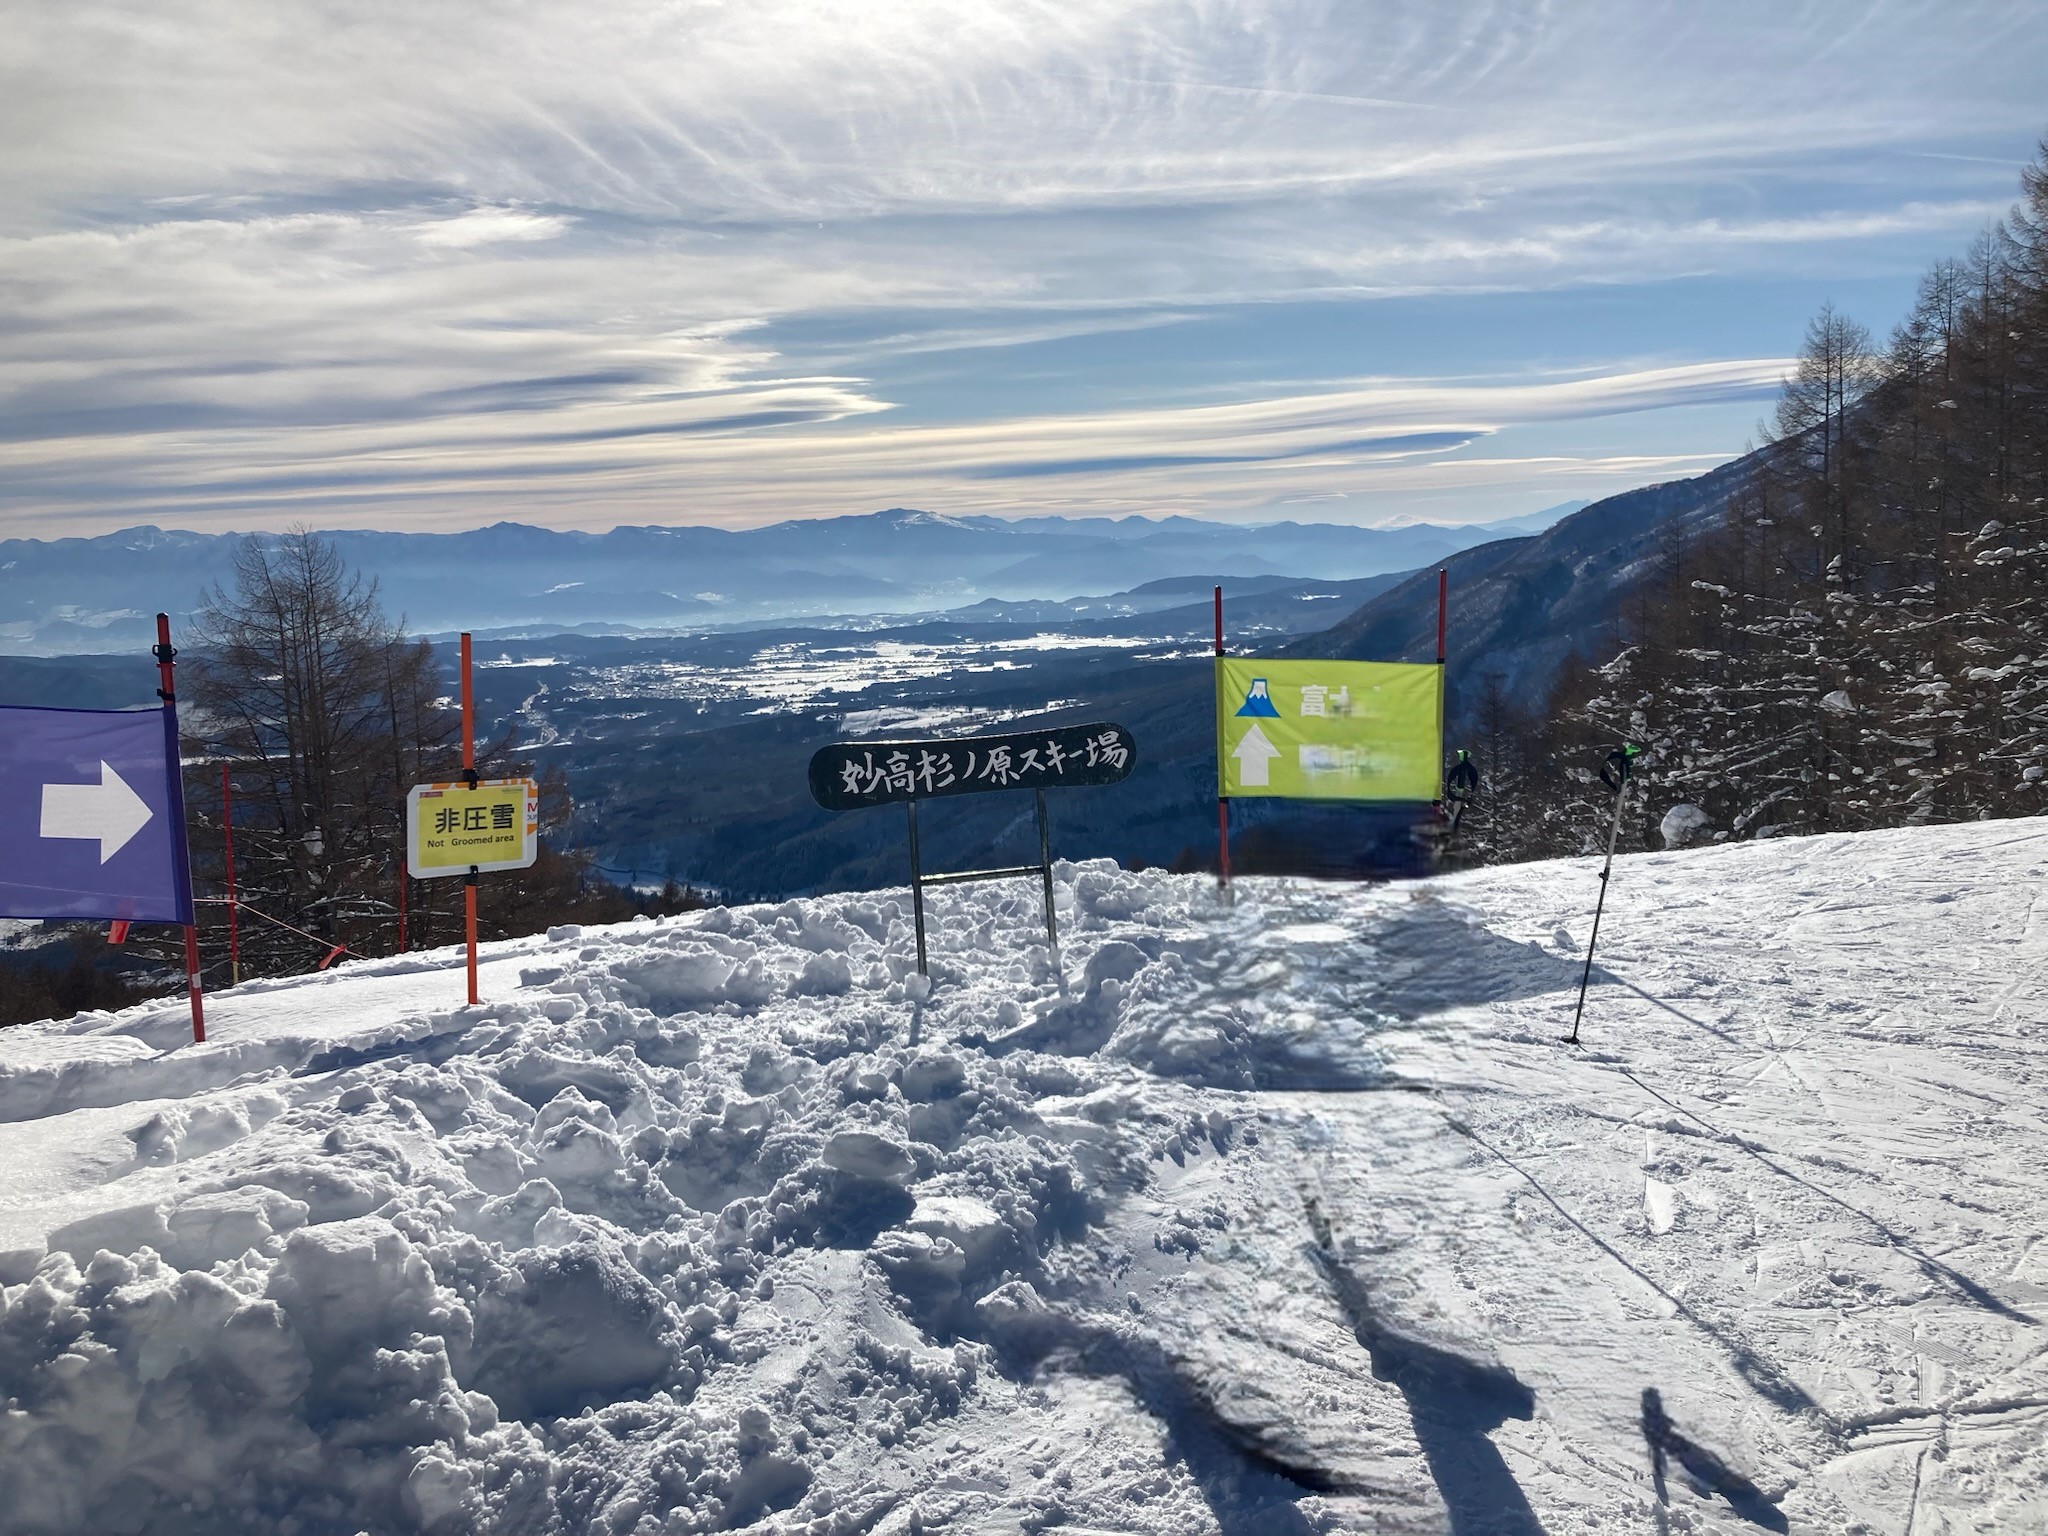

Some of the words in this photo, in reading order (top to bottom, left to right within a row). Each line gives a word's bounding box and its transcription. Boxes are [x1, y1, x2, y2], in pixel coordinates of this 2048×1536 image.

[839, 730, 1128, 794] 妙高杉ノ原スキー場
[435, 803, 515, 834] 非圧雪
[427, 839, 444, 848] Not
[451, 834, 493, 846] Groomed
[495, 834, 514, 843] area
